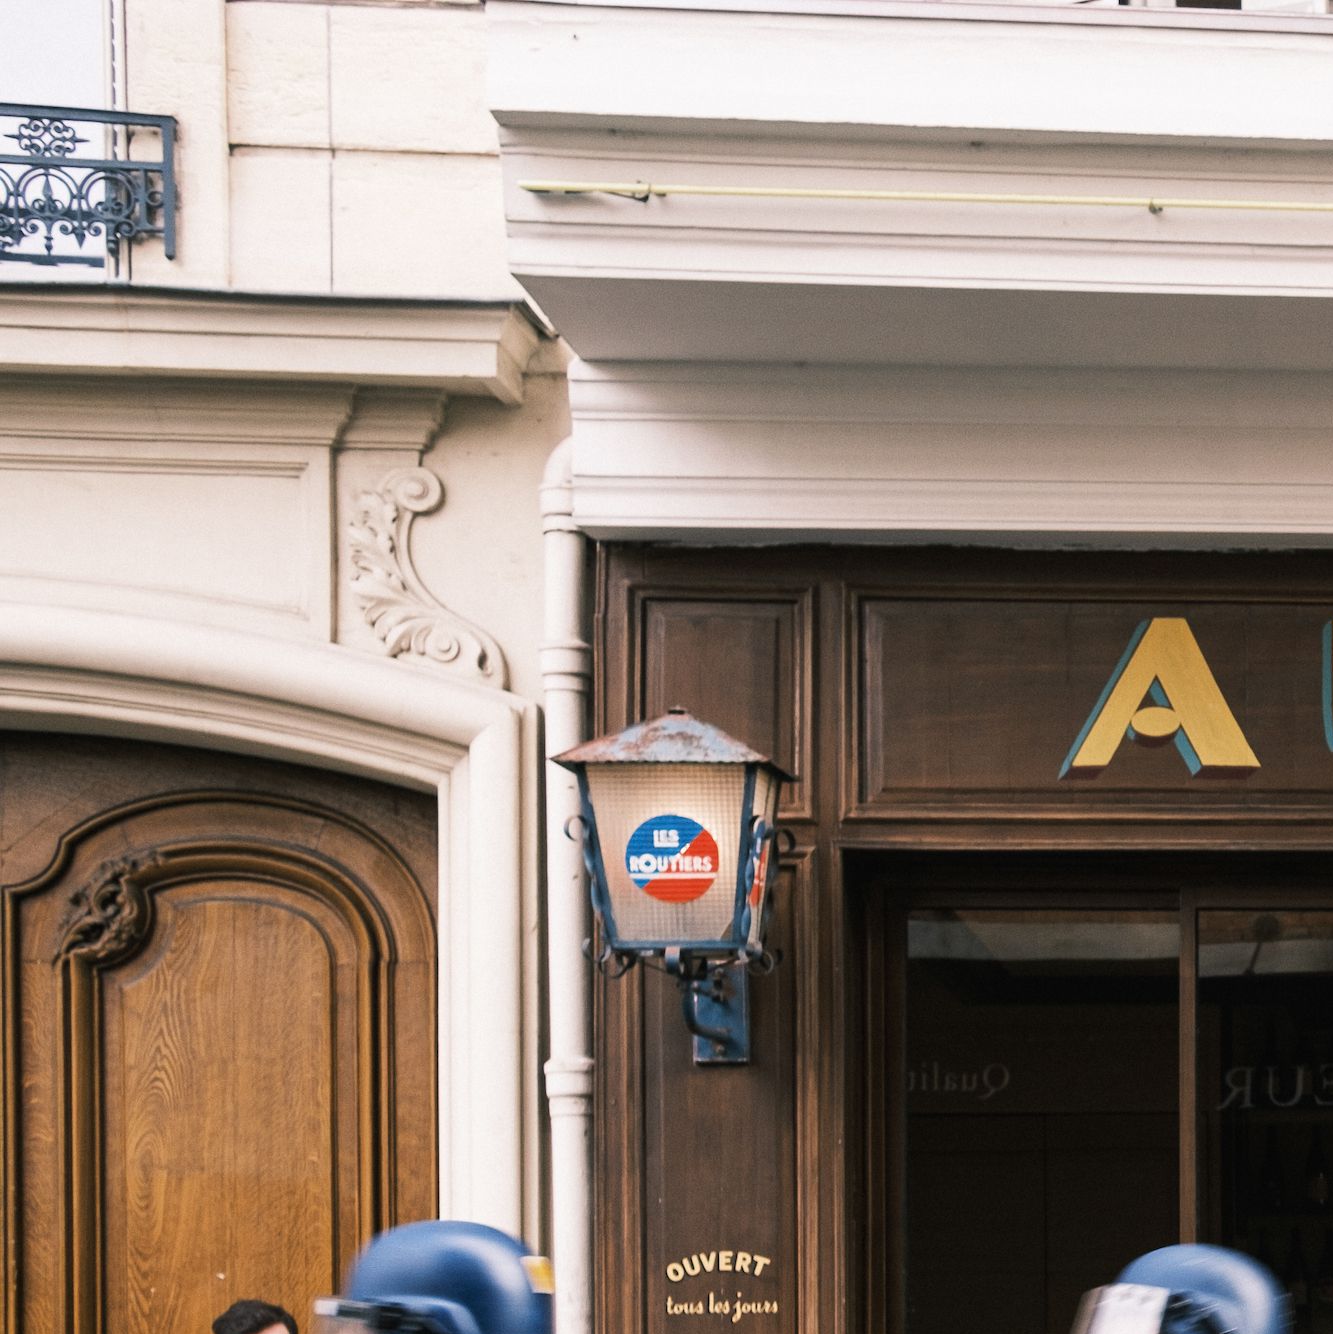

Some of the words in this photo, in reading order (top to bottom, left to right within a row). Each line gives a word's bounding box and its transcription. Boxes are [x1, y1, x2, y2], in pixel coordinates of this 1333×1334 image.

[653, 829, 680, 848] LES
[629, 852, 713, 873] ROUTIERS
[666, 1250, 771, 1283] OUVERT
[666, 1296, 704, 1315] tous
[709, 1291, 730, 1315] les
[731, 1291, 778, 1324] jours
